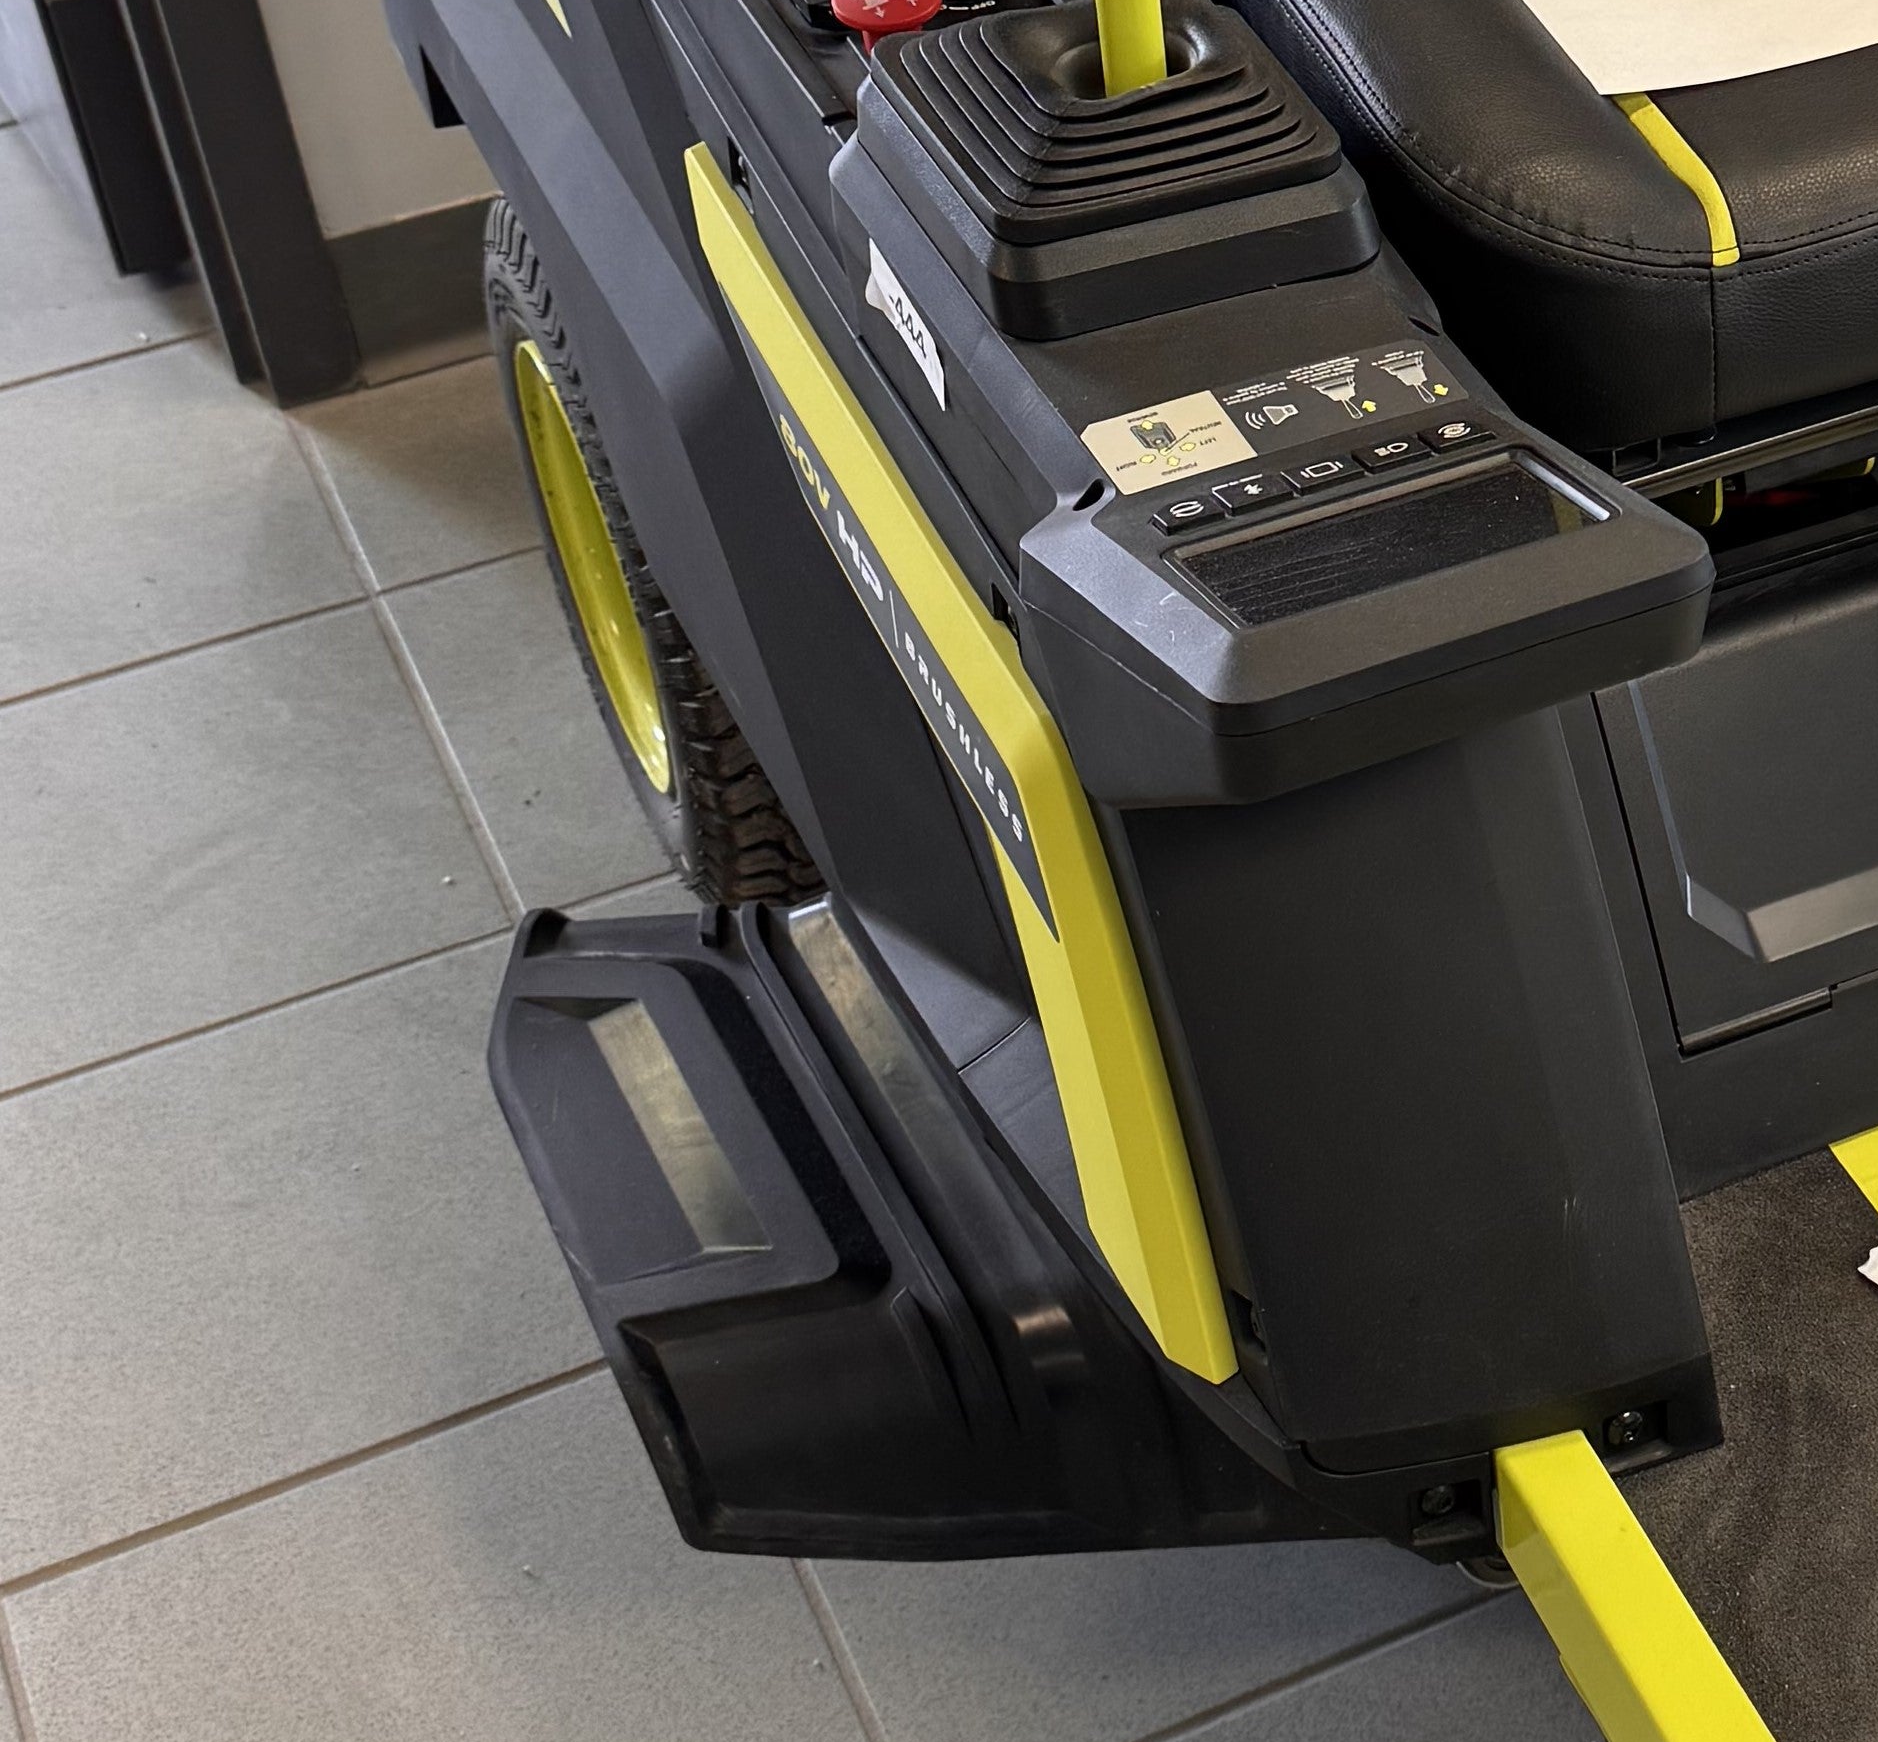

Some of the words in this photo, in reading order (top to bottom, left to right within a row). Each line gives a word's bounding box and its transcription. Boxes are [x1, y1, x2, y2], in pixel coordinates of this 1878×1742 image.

[779, 413, 830, 513] 80V
[836, 509, 885, 603] HP
[904, 631, 1024, 843] BRUSHLESS
